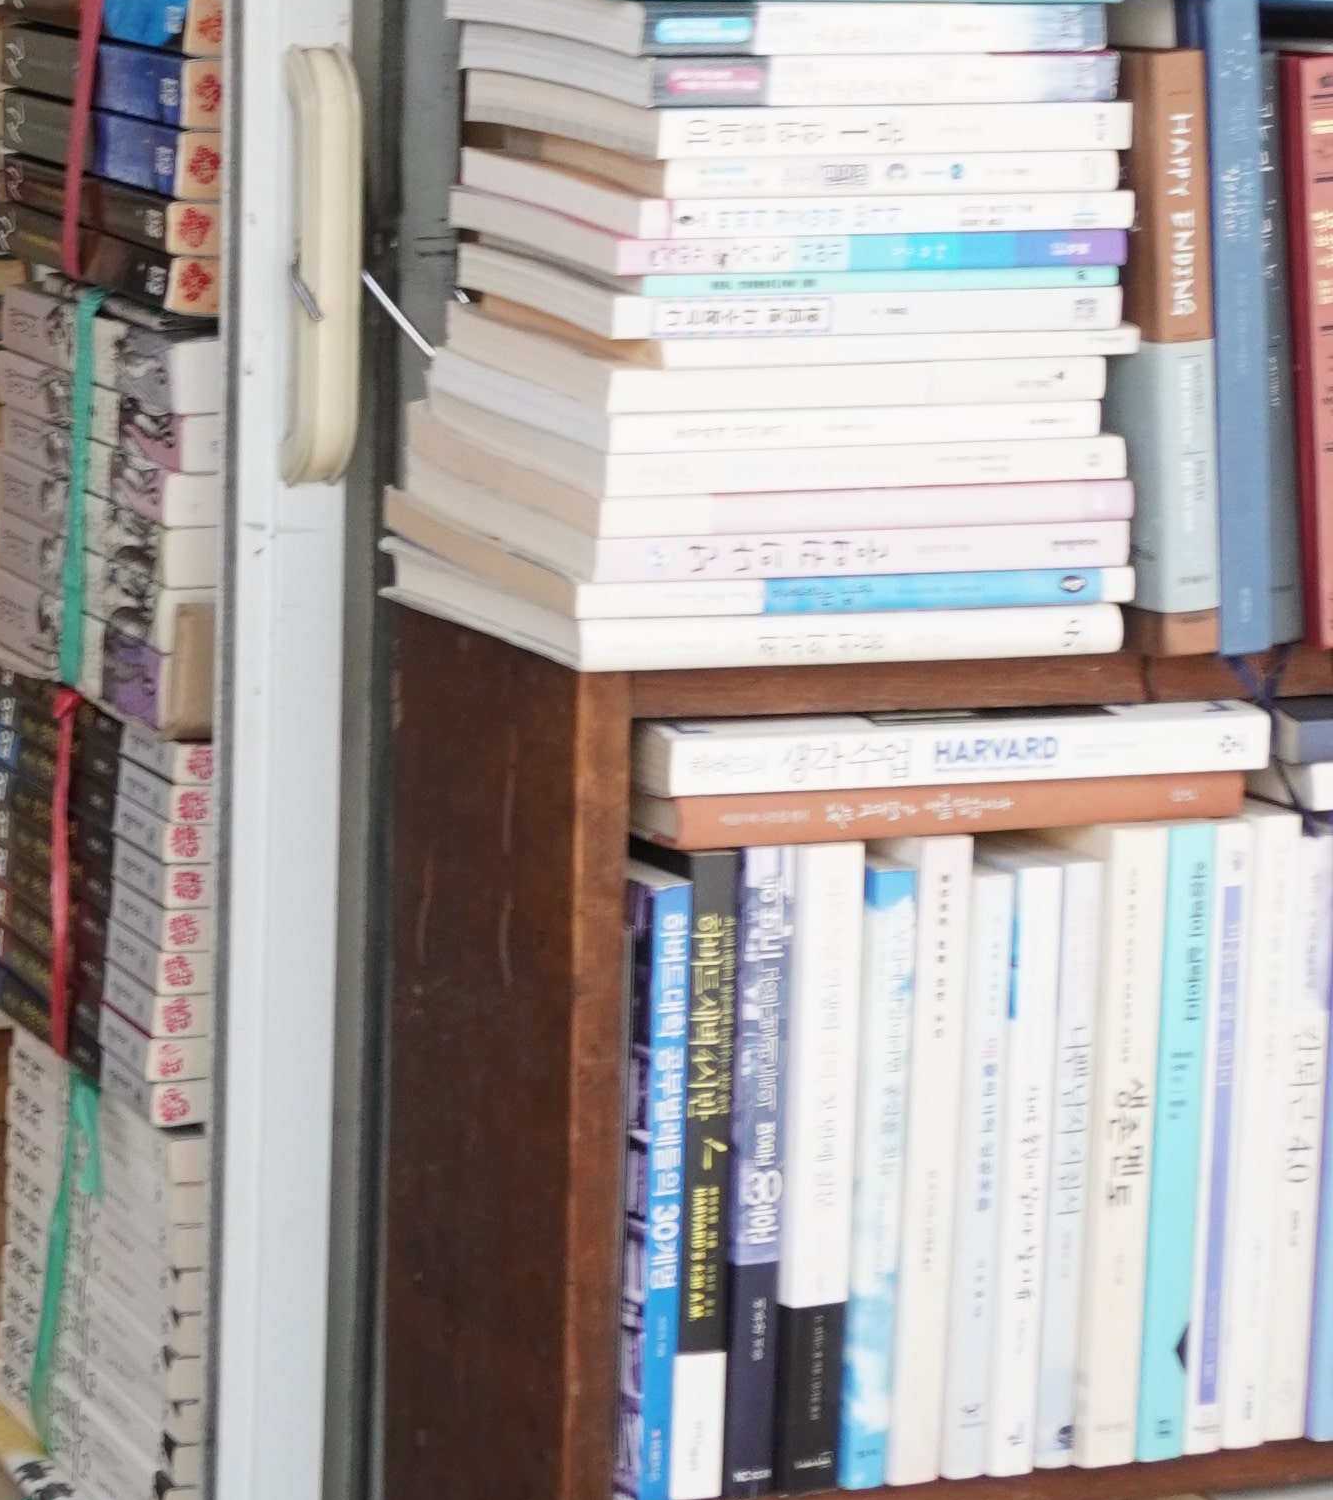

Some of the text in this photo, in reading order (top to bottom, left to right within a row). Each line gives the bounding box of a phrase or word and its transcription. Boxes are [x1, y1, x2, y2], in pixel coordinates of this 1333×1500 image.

[1167, 113, 1196, 320] HAPPY ENDING
[933, 733, 1060, 767] HARVARD
[1284, 1136, 1317, 1184] 4.0
[649, 1203, 681, 1290] 30계명
